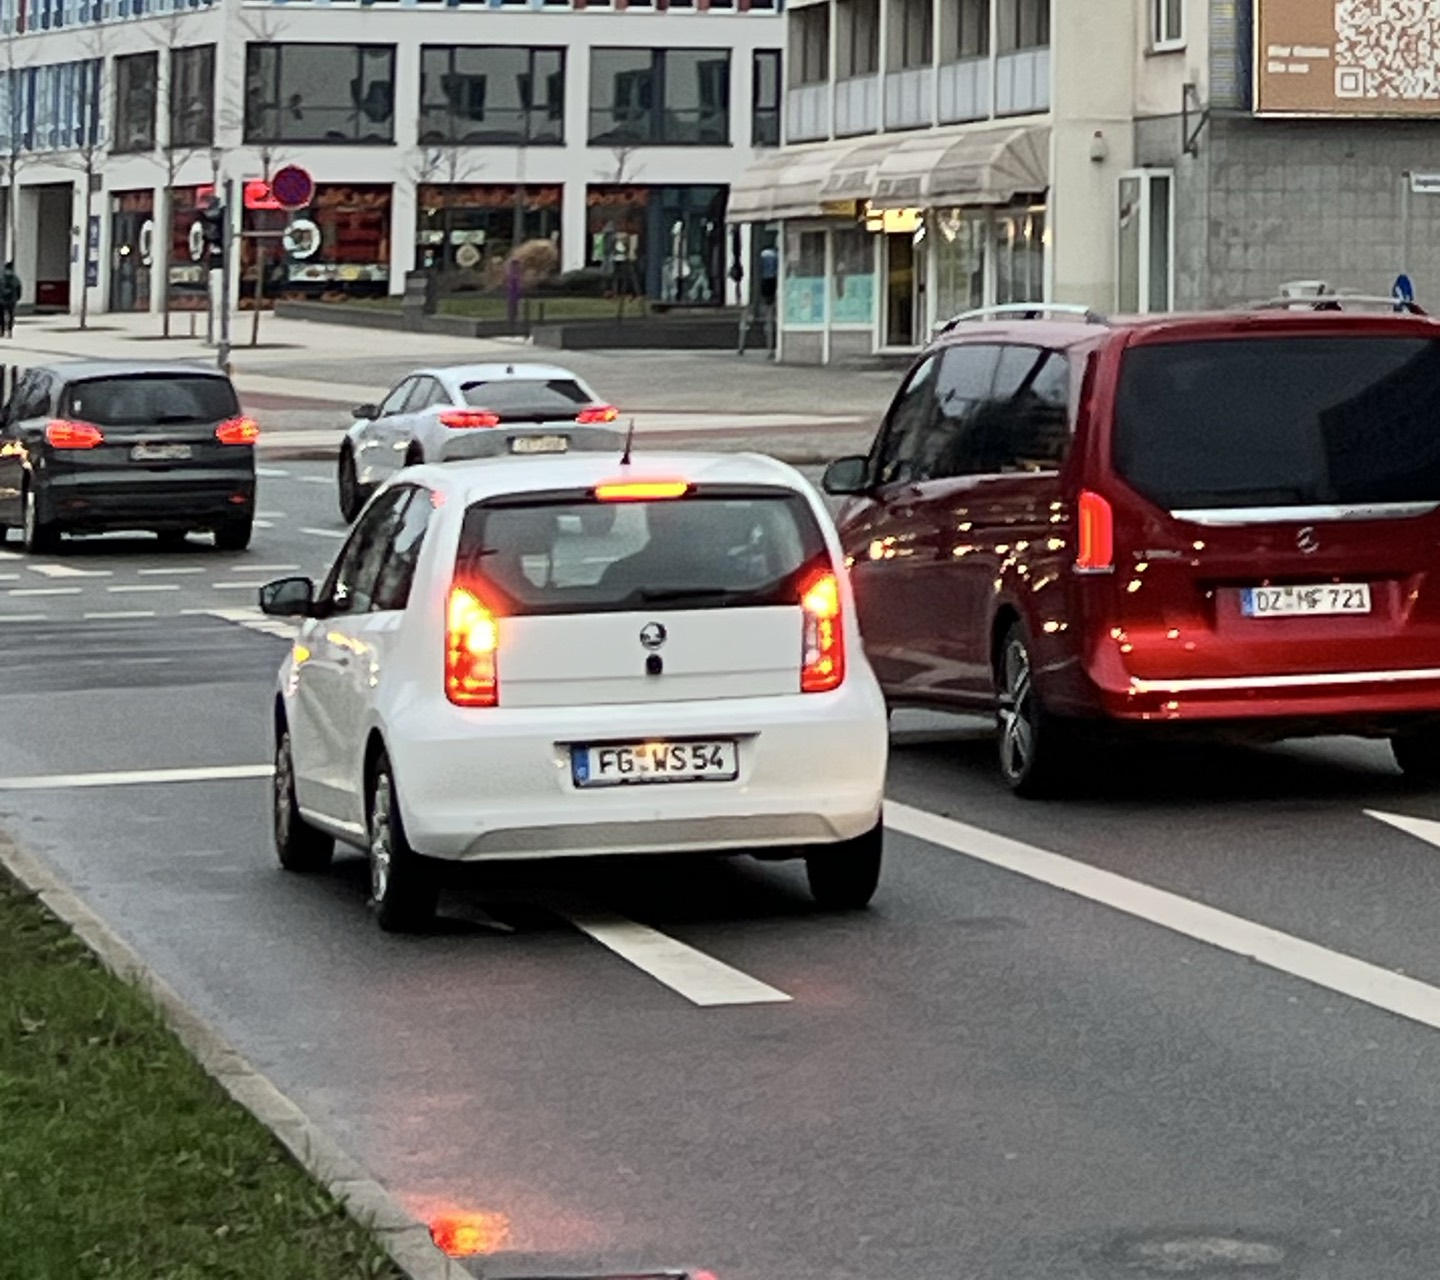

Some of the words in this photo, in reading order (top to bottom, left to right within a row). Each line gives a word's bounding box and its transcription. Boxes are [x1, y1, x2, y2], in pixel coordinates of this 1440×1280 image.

[1328, 589, 1366, 608] 721
[600, 749, 633, 774] FG
[653, 746, 687, 771] WS
[692, 745, 723, 770] 54
